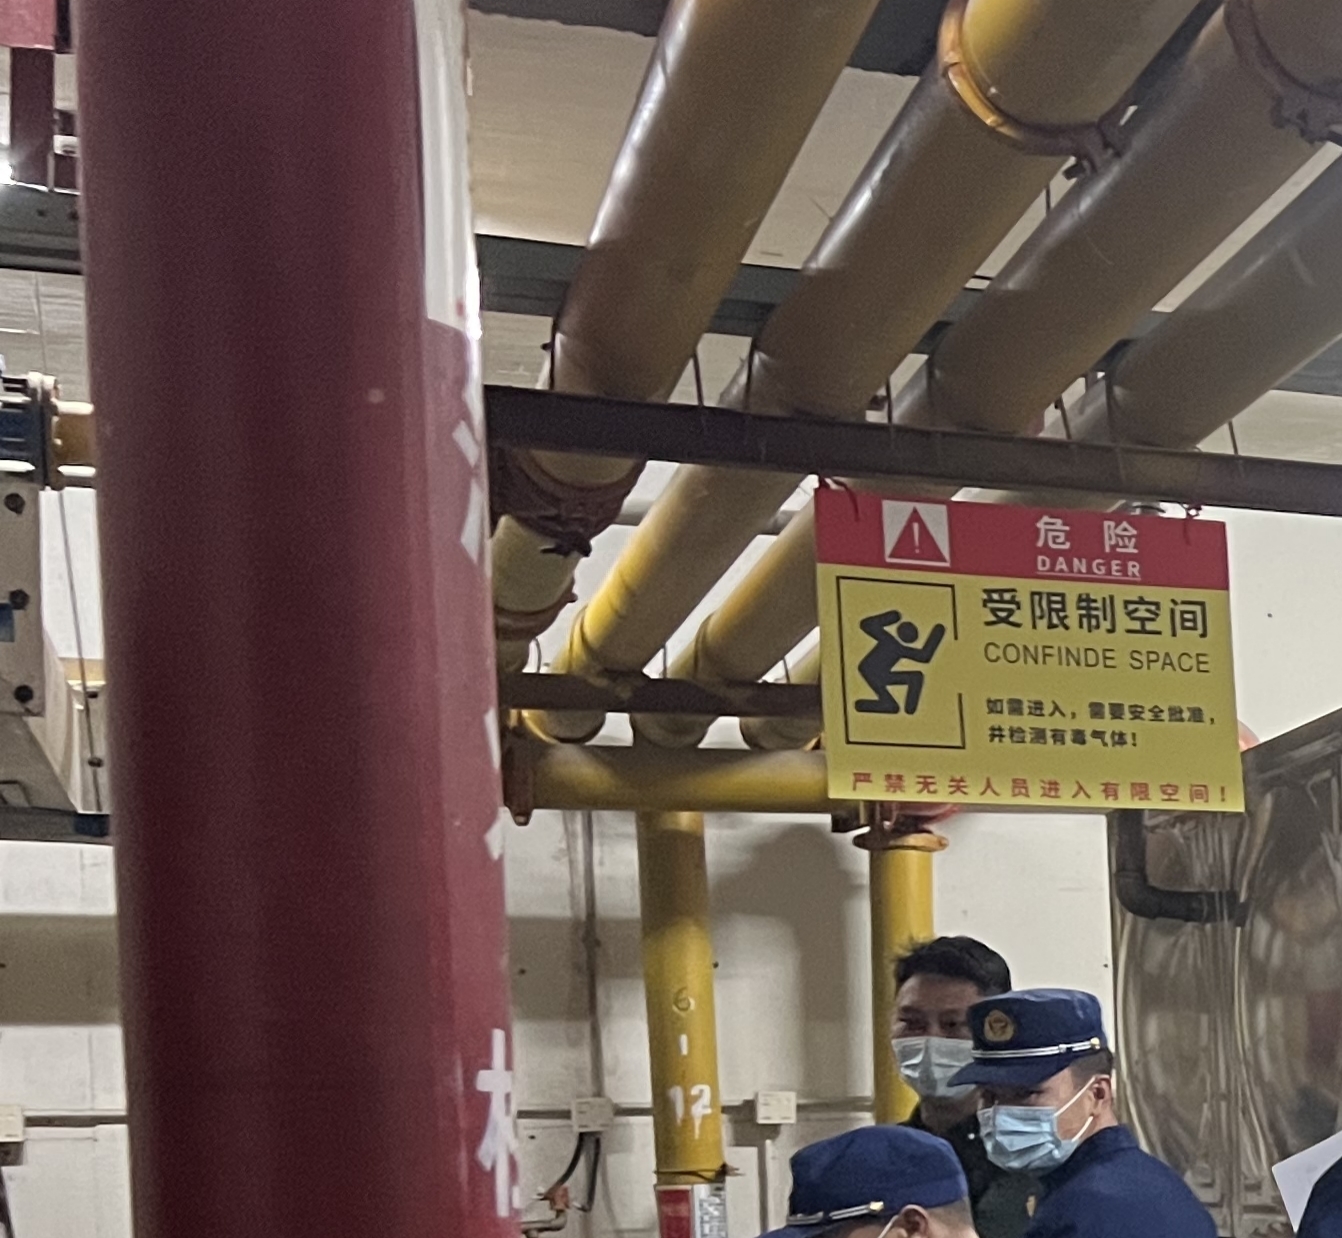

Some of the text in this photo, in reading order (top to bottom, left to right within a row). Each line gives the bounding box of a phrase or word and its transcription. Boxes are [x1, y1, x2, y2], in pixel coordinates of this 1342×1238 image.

[1035, 514, 1140, 555] 危险
[1036, 555, 1141, 578] DANGER
[981, 588, 1209, 639] 受限制空间
[983, 641, 1211, 674] CONFINDE SPACE
[668, 1084, 713, 1124] 12
